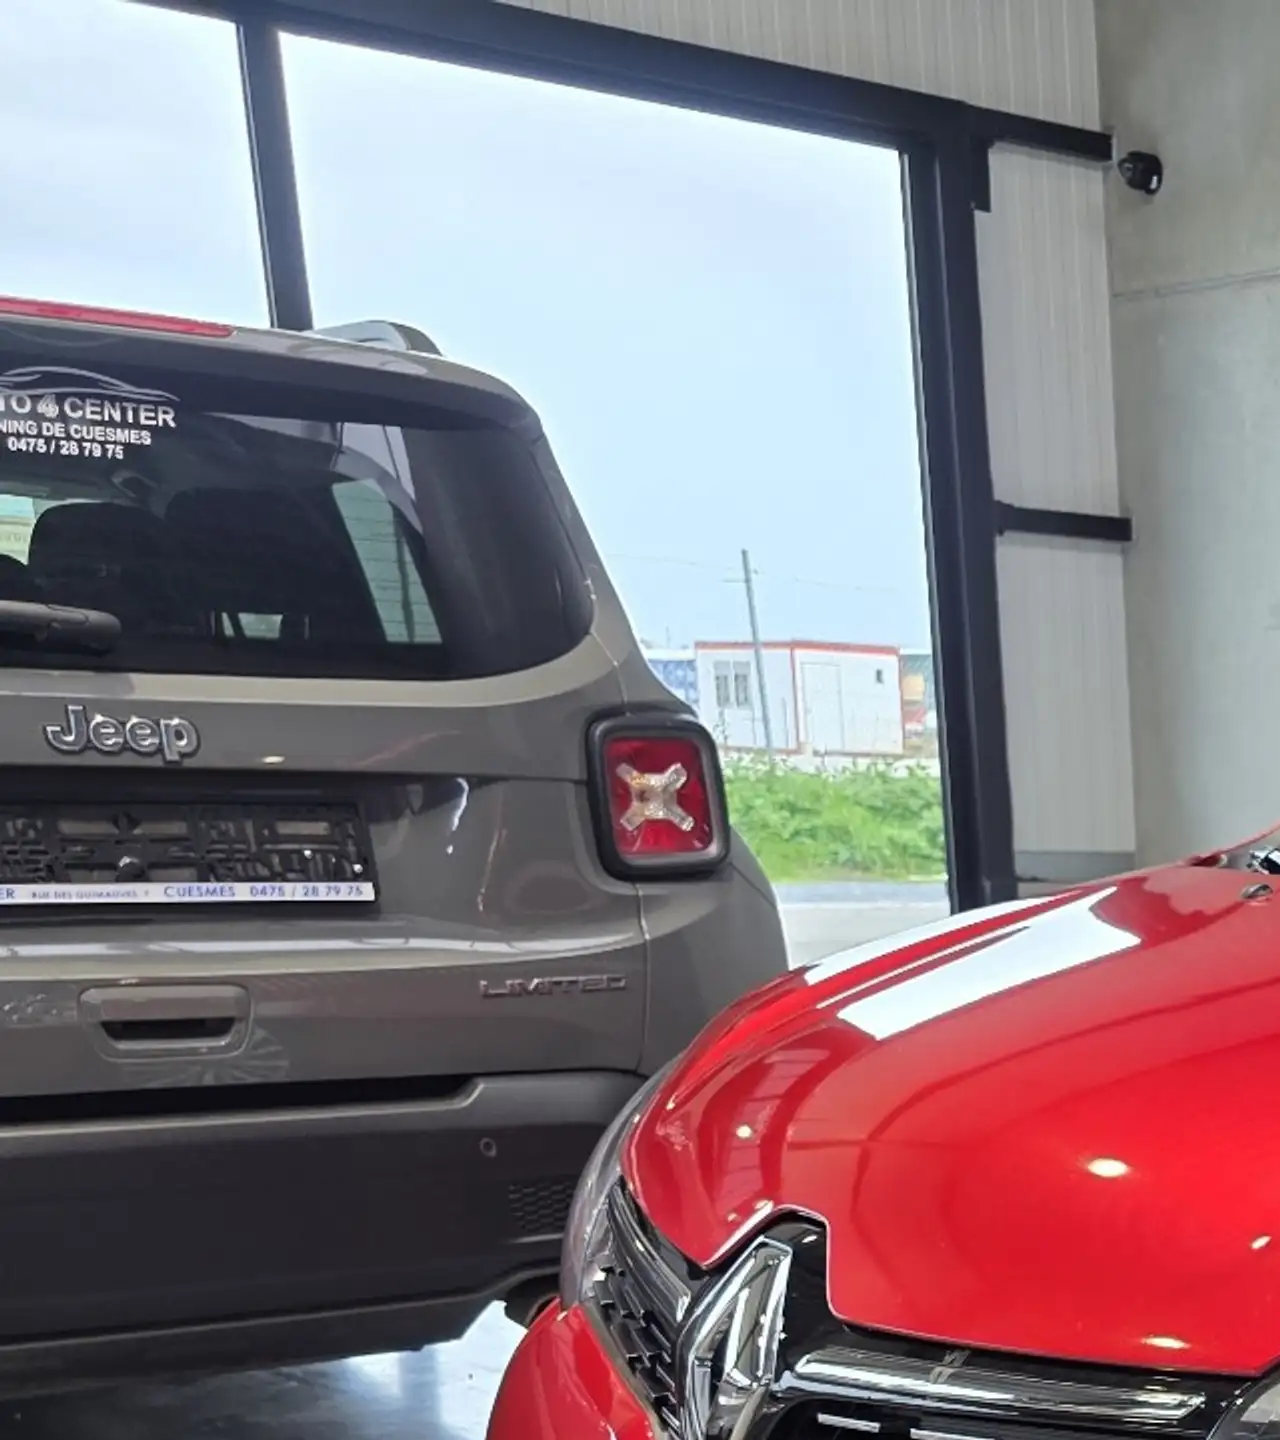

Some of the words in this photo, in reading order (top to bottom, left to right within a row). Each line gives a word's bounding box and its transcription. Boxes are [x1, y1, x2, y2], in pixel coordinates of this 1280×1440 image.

[64, 396, 177, 428] CENTER
[42, 421, 66, 438] DE
[70, 424, 152, 446] CUESMES
[7, 436, 47, 454] 0475
[60, 440, 79, 456] 28
[82, 442, 101, 458] 79
[104, 443, 125, 460] 75
[44, 704, 201, 764] Jeep
[164, 886, 236, 898] CUESMES
[250, 886, 286, 898] 0475
[302, 886, 319, 897] 28
[479, 974, 627, 997] LIMITED
